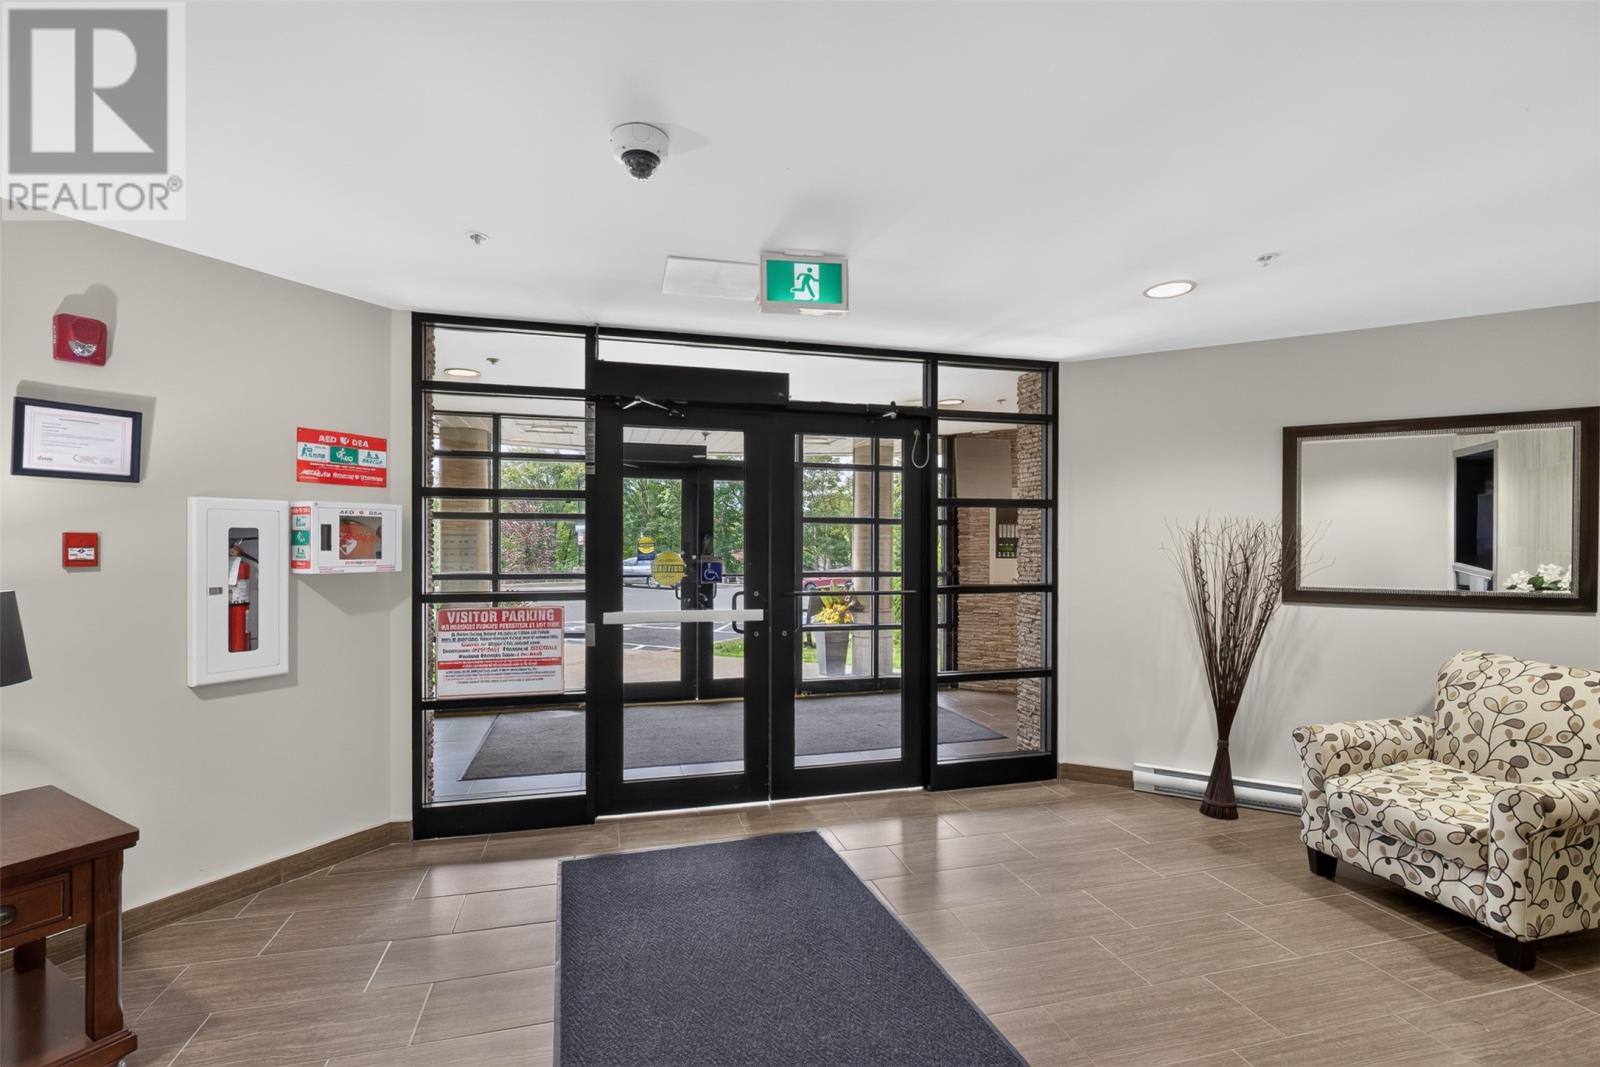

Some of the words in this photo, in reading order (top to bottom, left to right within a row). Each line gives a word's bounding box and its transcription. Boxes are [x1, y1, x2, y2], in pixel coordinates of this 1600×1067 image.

[318, 434, 337, 444] AED
[352, 439, 369, 448] DEA
[447, 610, 498, 624] VISITOR
[501, 608, 554, 622] PARKING
